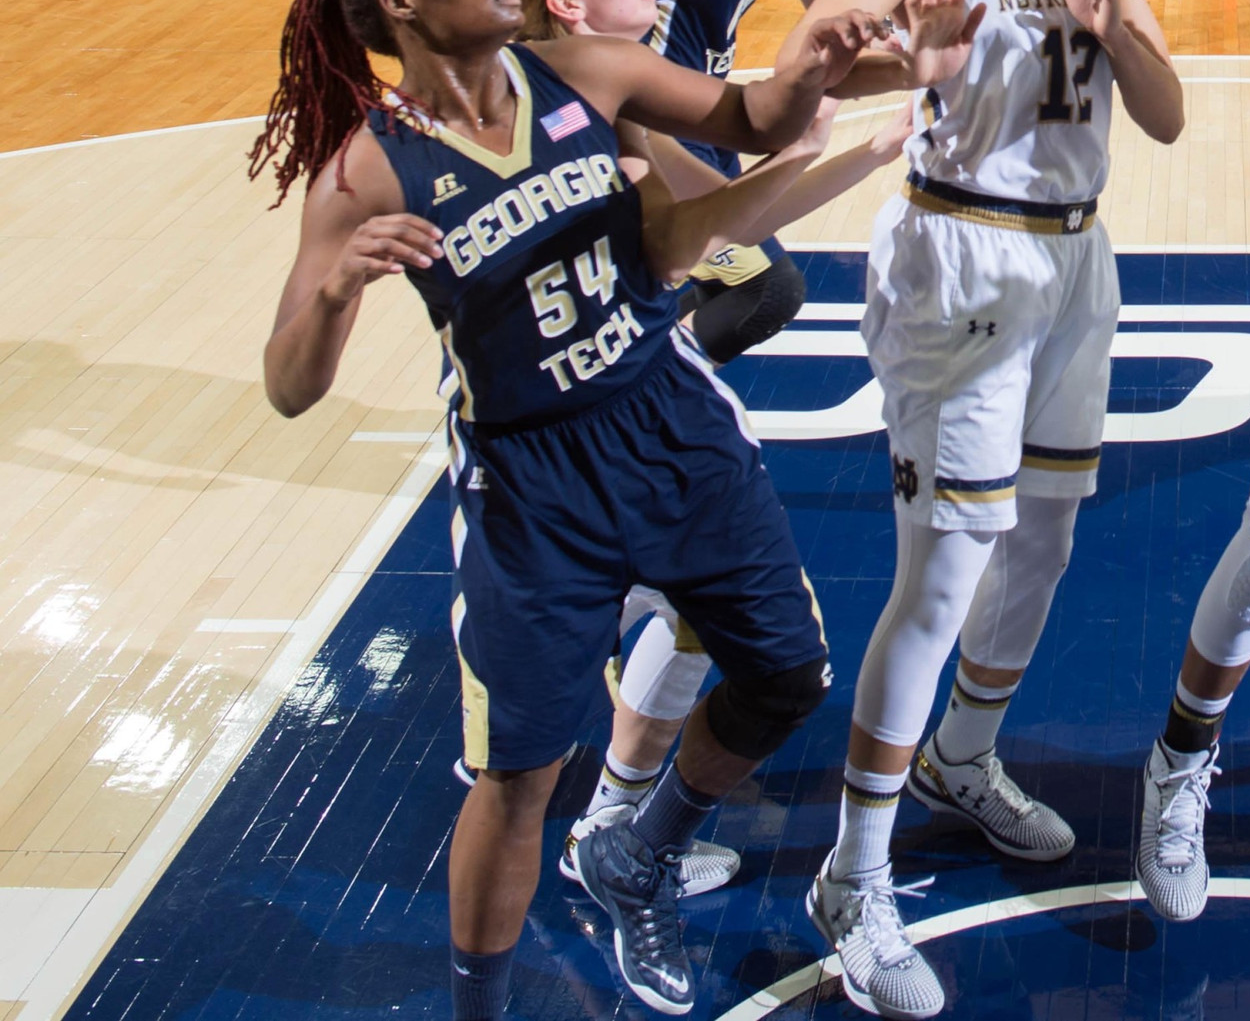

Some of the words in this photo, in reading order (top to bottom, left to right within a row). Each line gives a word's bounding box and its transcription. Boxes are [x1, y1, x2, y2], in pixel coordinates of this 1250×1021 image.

[1037, 26, 1103, 124] 12
[442, 153, 624, 277] GEORGIA
[525, 235, 619, 338] 54
[539, 302, 645, 392] TECH
